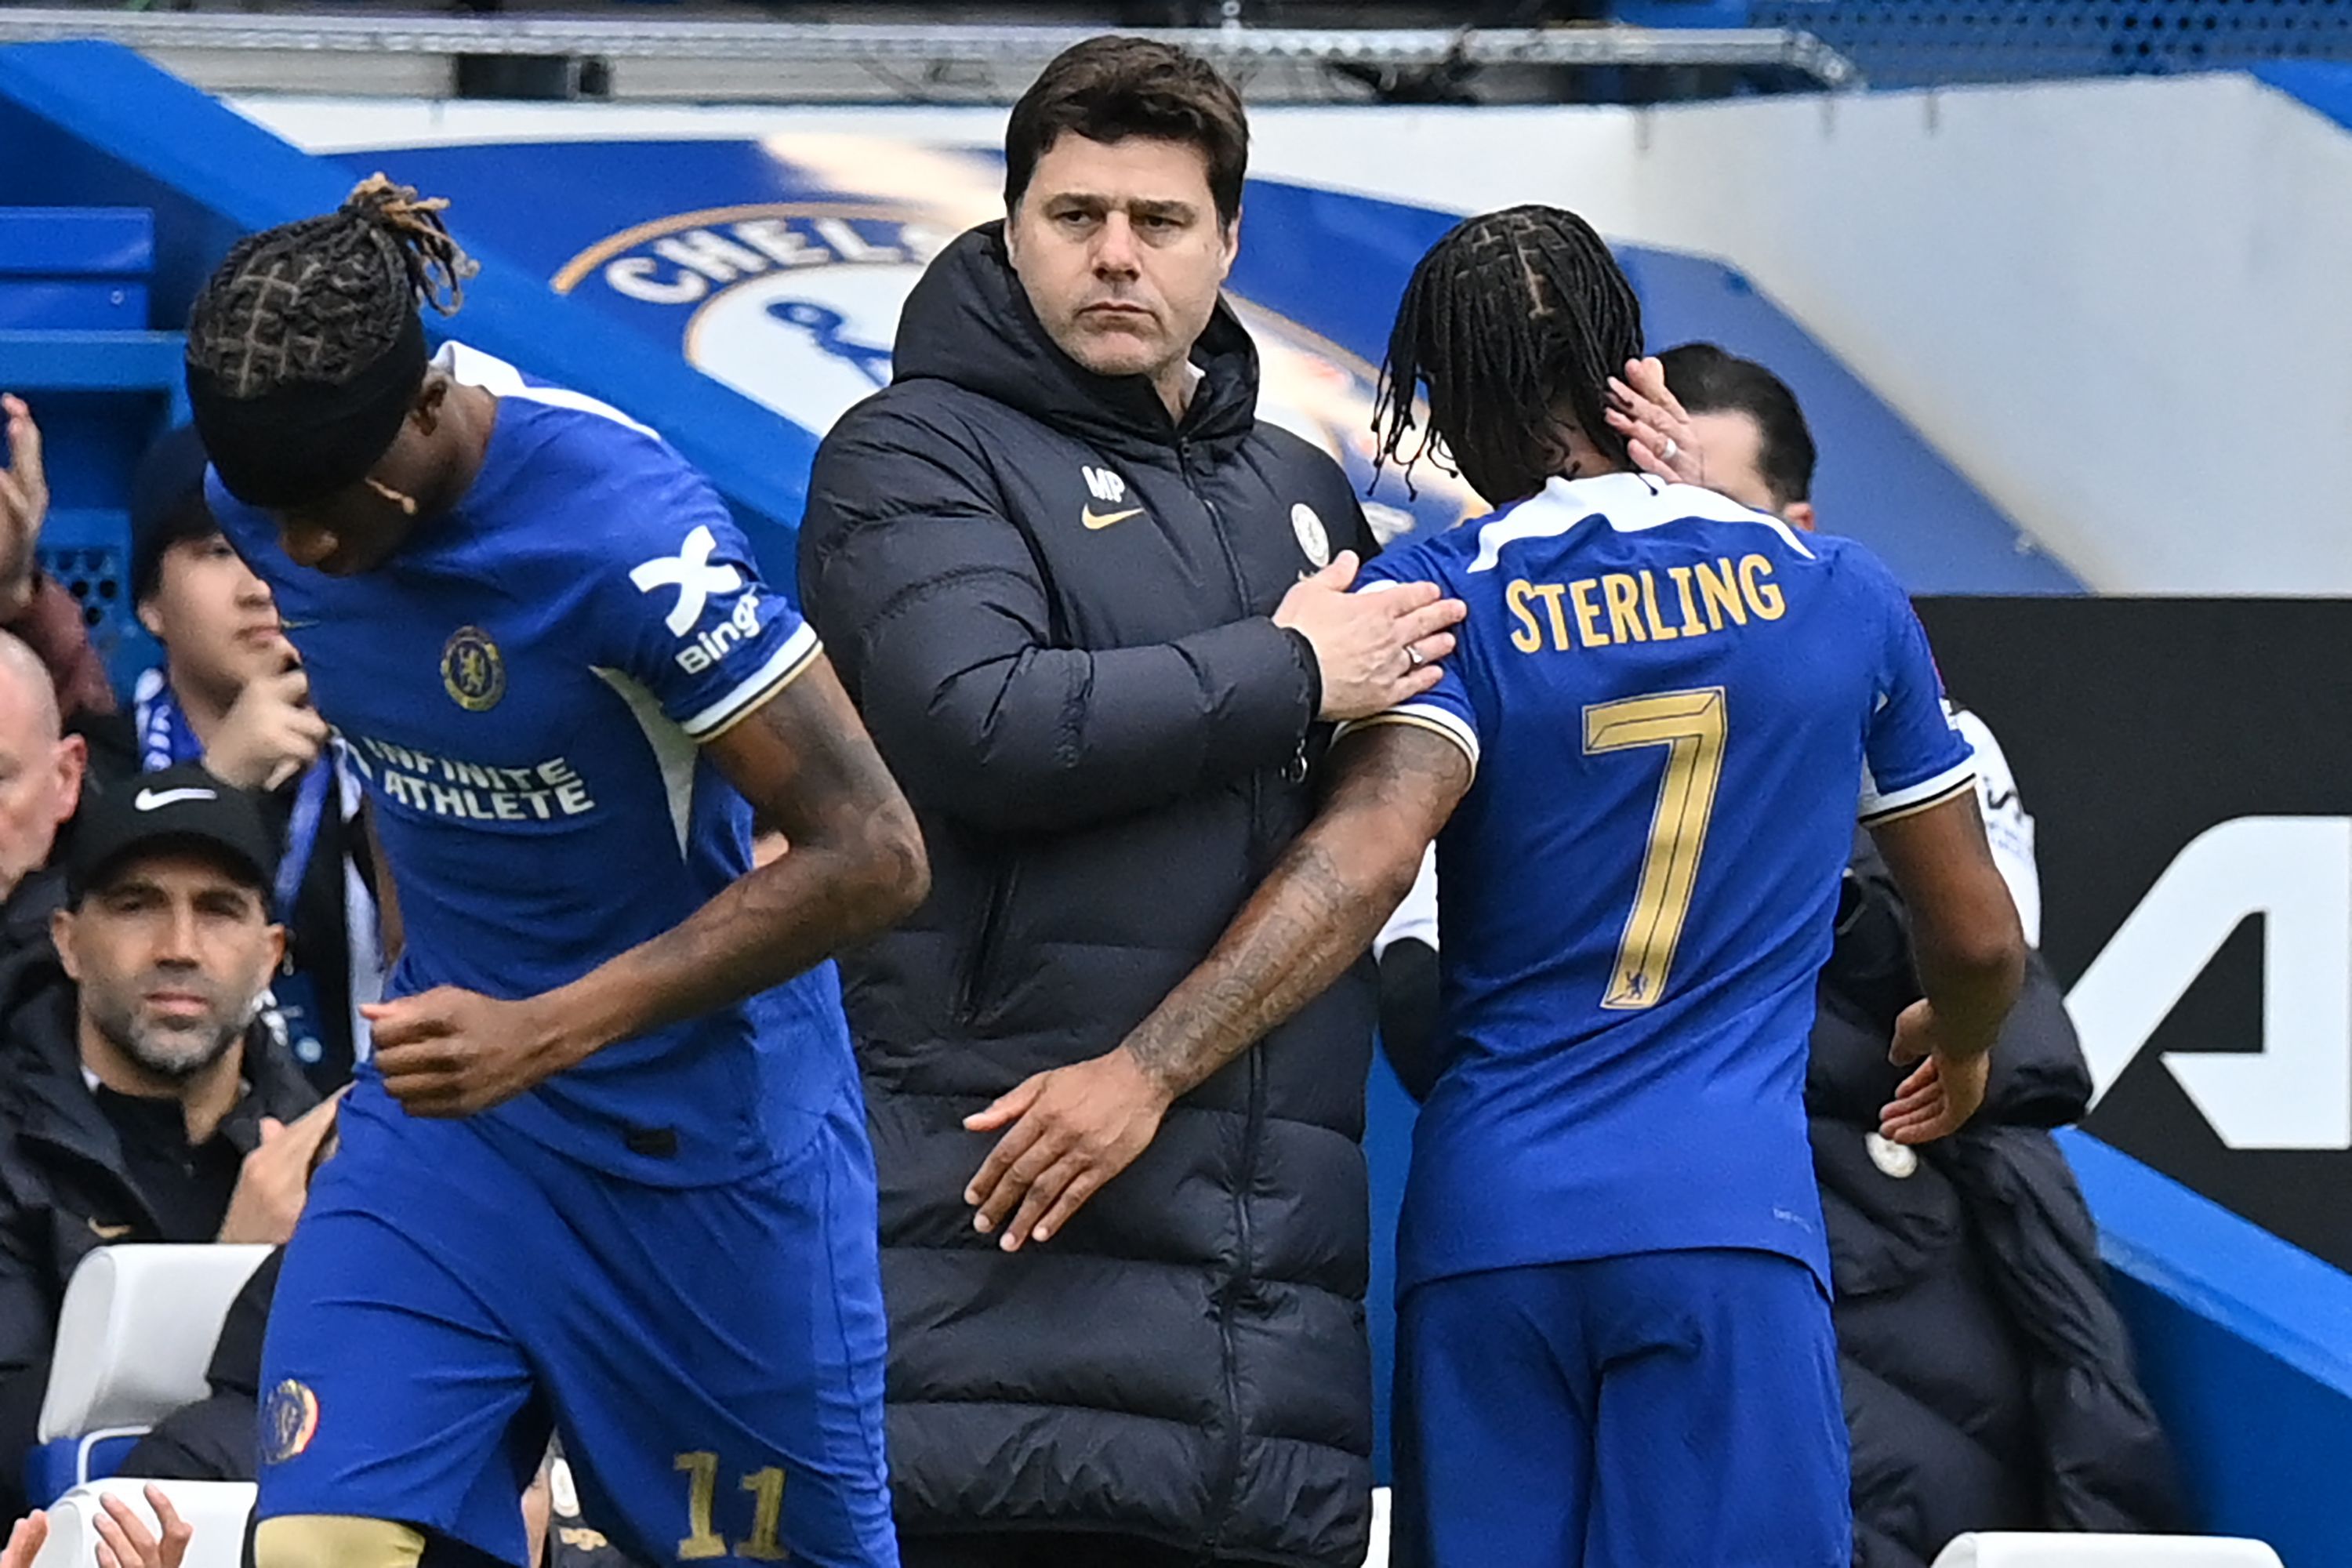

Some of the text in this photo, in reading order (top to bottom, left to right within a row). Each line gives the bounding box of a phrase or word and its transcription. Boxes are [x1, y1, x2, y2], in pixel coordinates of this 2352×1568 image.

[1082, 465, 1127, 503] MP
[1505, 554, 1786, 654] STERLING
[361, 735, 576, 790] INFINITE
[384, 769, 595, 820] ATHLETE
[1582, 685, 1727, 1010] 7
[673, 1450, 789, 1561] 11
